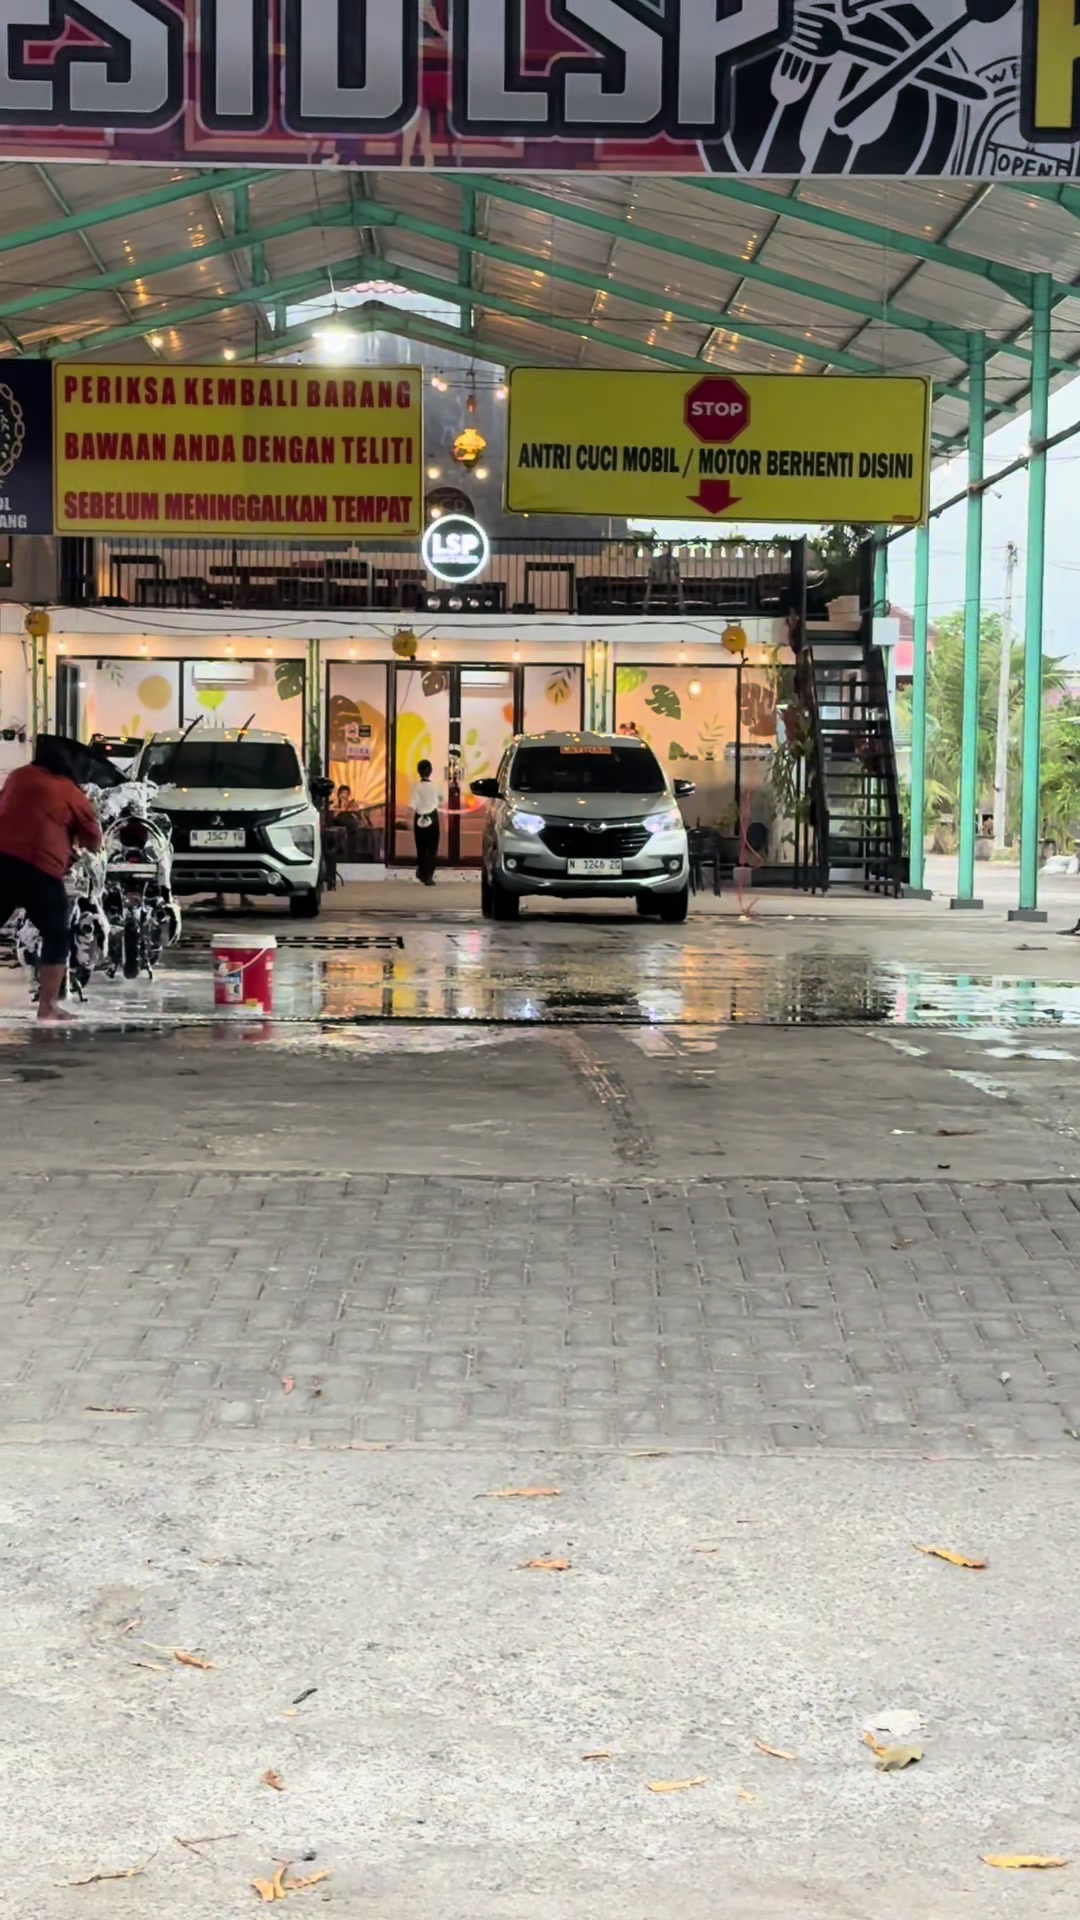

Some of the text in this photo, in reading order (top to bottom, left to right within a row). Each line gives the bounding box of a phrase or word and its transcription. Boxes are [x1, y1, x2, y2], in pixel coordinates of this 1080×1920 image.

[997, 153, 1053, 176] OPEN
[64, 375, 412, 409] PERIKSA KEMBALI BARANG
[690, 402, 743, 417] STOP
[64, 432, 413, 465] BAWAAN ANDA DENGAN TELITI
[518, 443, 571, 469] ANTRI
[576, 445, 617, 471] CUCI
[622, 446, 680, 473] MOBIL
[699, 449, 762, 475] MOTOR
[766, 450, 853, 478] BERHENTI
[858, 453, 913, 479] DISINI
[64, 491, 413, 524] SEBELUM MENINGGALKAN TEMPAT
[432, 533, 479, 555] LSP
[569, 860, 576, 869] N
